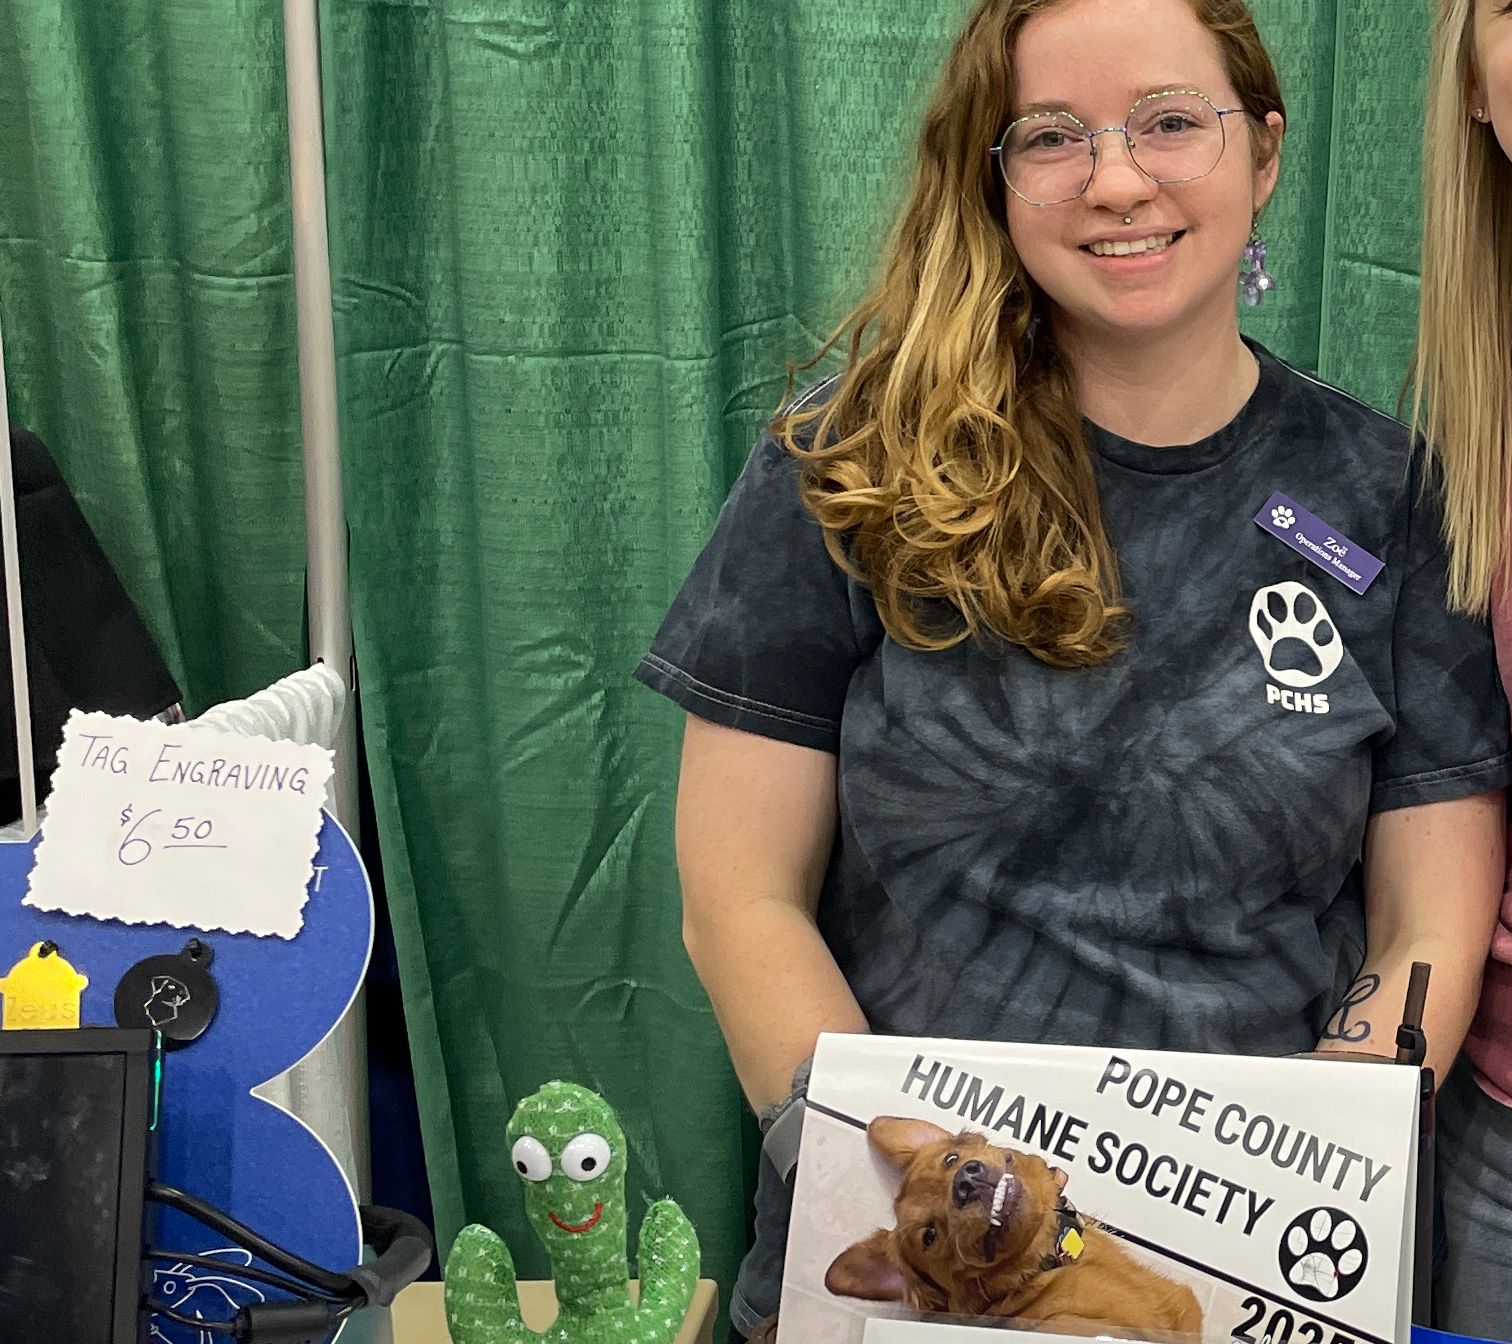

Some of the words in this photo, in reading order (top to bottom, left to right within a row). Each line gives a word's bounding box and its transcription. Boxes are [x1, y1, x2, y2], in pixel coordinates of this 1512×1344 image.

[1295, 532, 1332, 563] Operations
[1330, 556, 1362, 582] Manager
[1323, 537, 1349, 557] Zoë
[1266, 684, 1330, 713] PCHS
[79, 734, 128, 774] TAG
[149, 744, 309, 794] ENGRAVING
[7, 996, 75, 1022] Zeus
[901, 1054, 1090, 1163] HUMANE
[1087, 1130, 1275, 1237] SOCIETY
[1095, 1055, 1214, 1134] POPE
[1214, 1102, 1392, 1203] COUNTY
